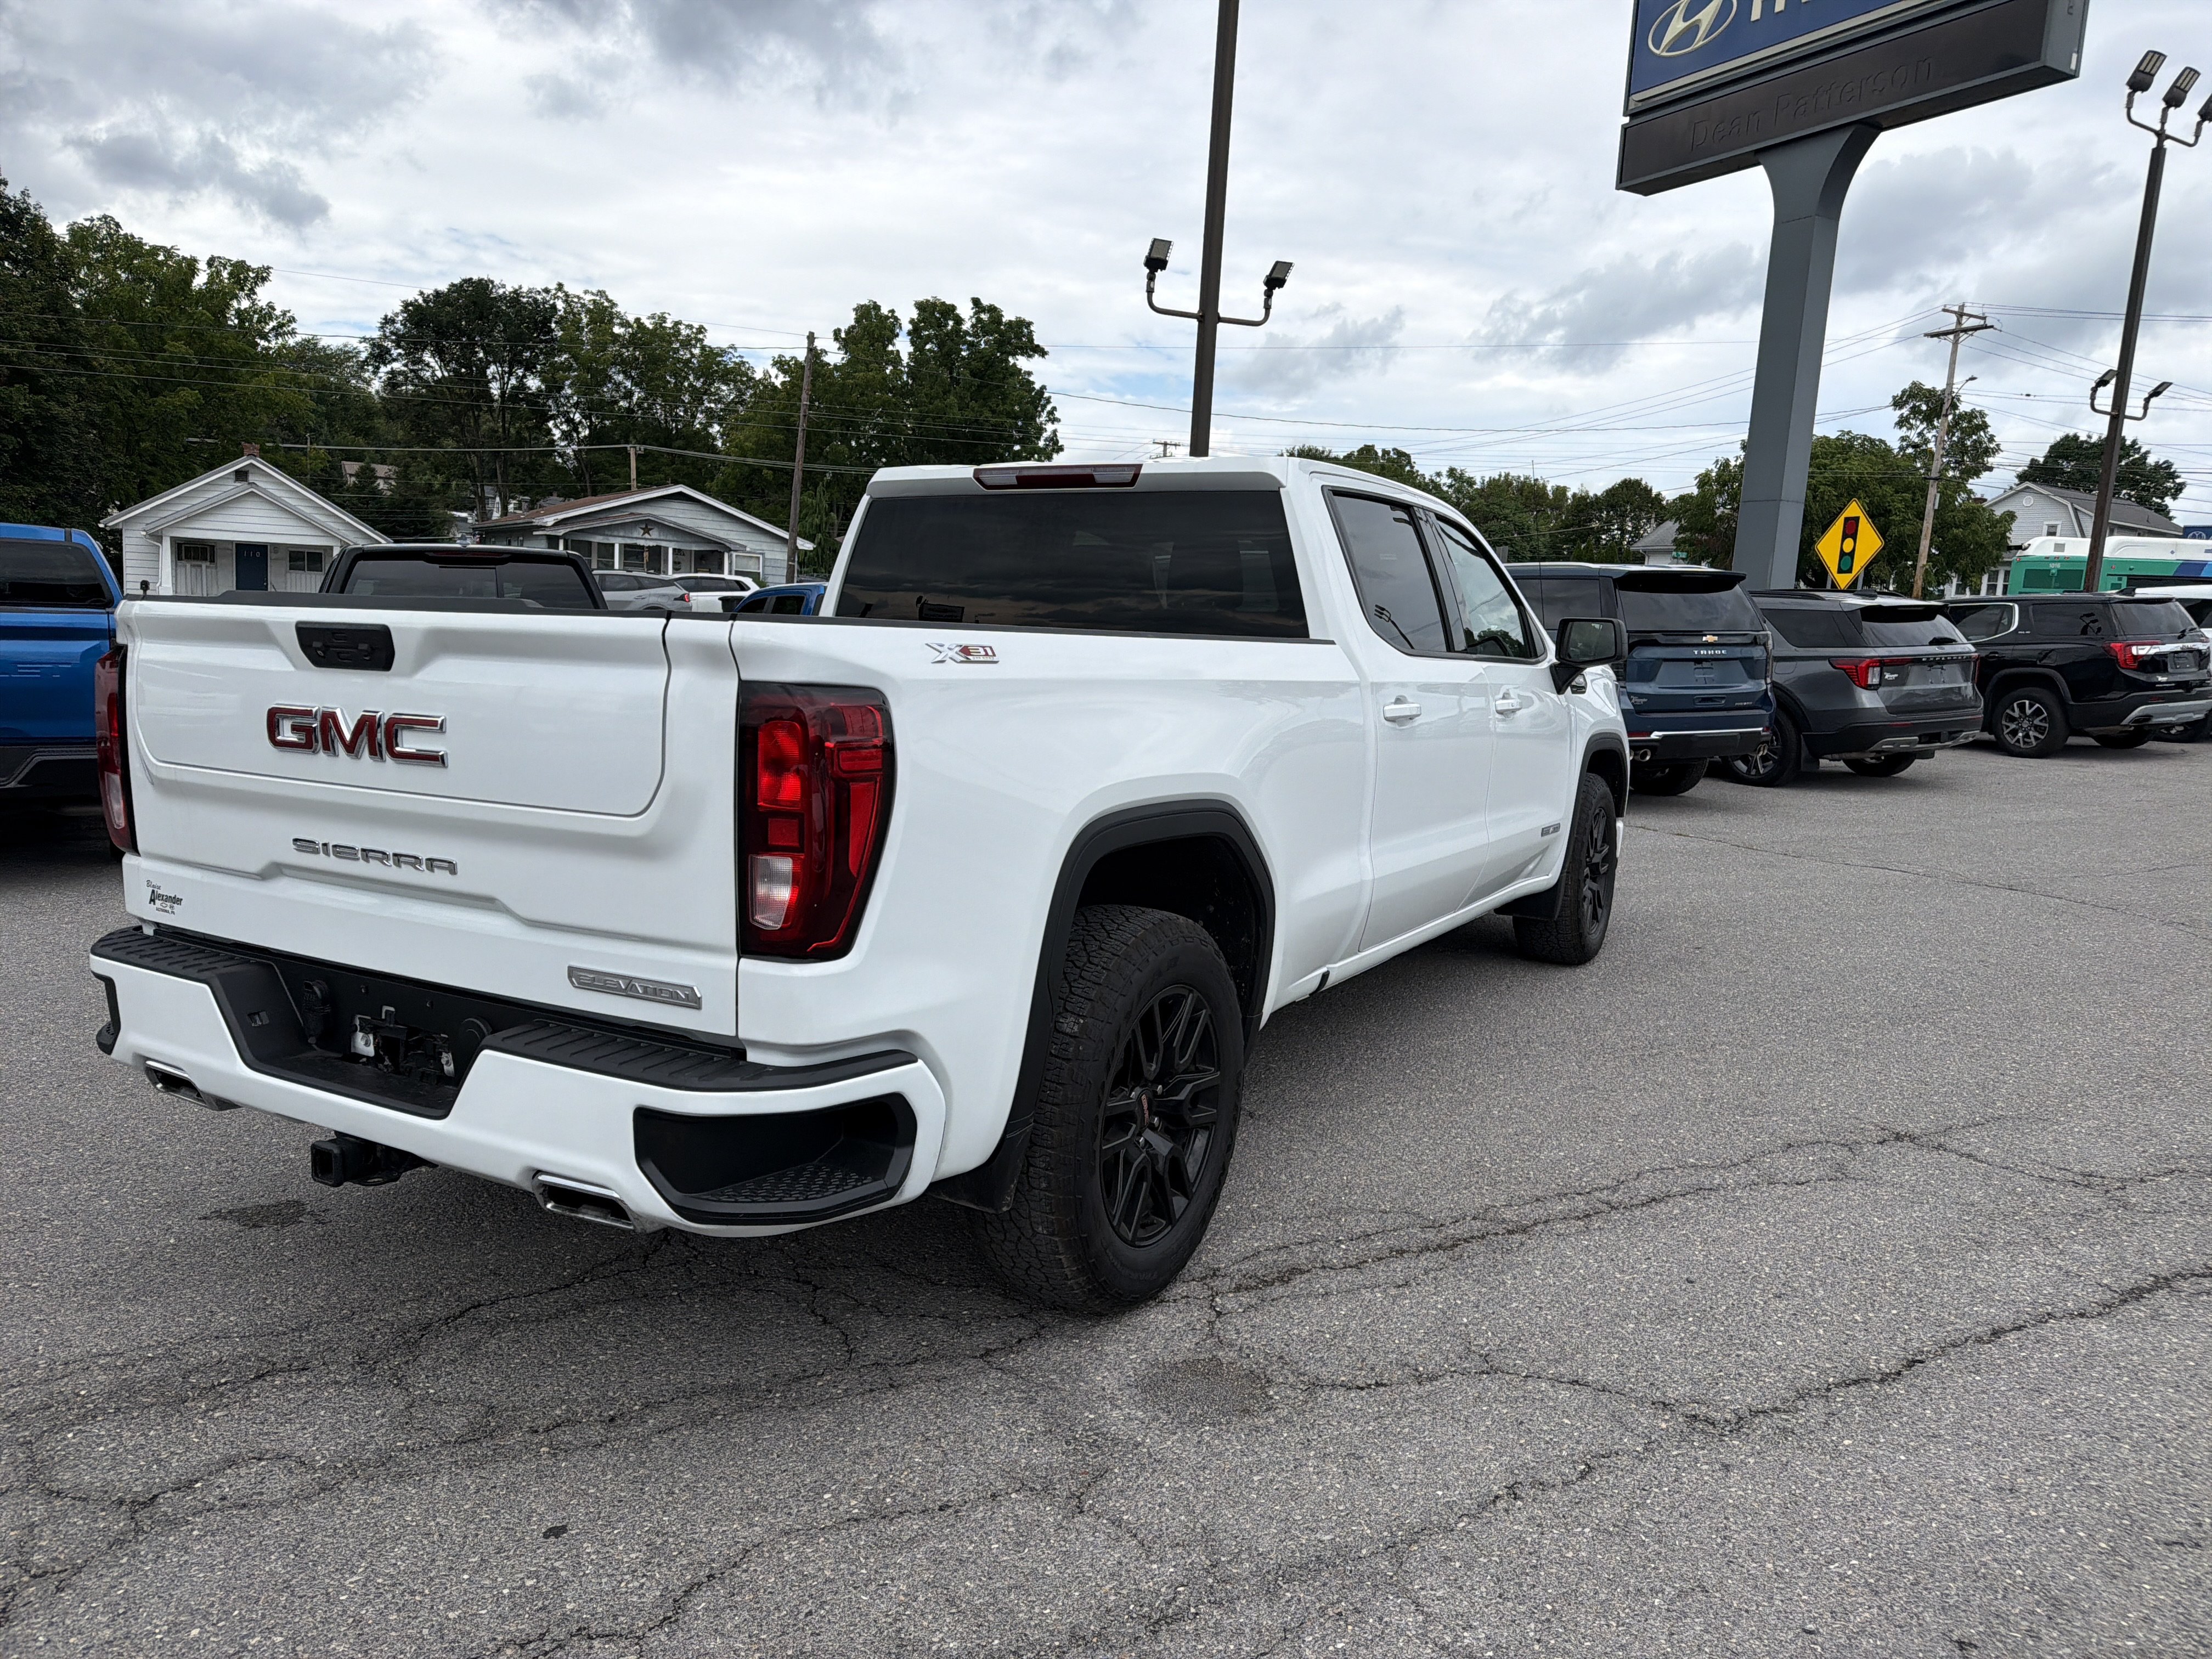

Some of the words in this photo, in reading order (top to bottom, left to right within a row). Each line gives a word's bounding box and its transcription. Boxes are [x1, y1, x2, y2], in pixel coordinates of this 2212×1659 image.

[1691, 110, 1760, 152] Dean
[1773, 56, 1934, 127] Patterson
[924, 642, 1000, 664] X31
[266, 703, 449, 769] GMC
[292, 837, 458, 876] SIERRA
[146, 879, 161, 890] Blaise
[149, 889, 183, 906] Alexander
[576, 972, 691, 1002] ELEVATION
